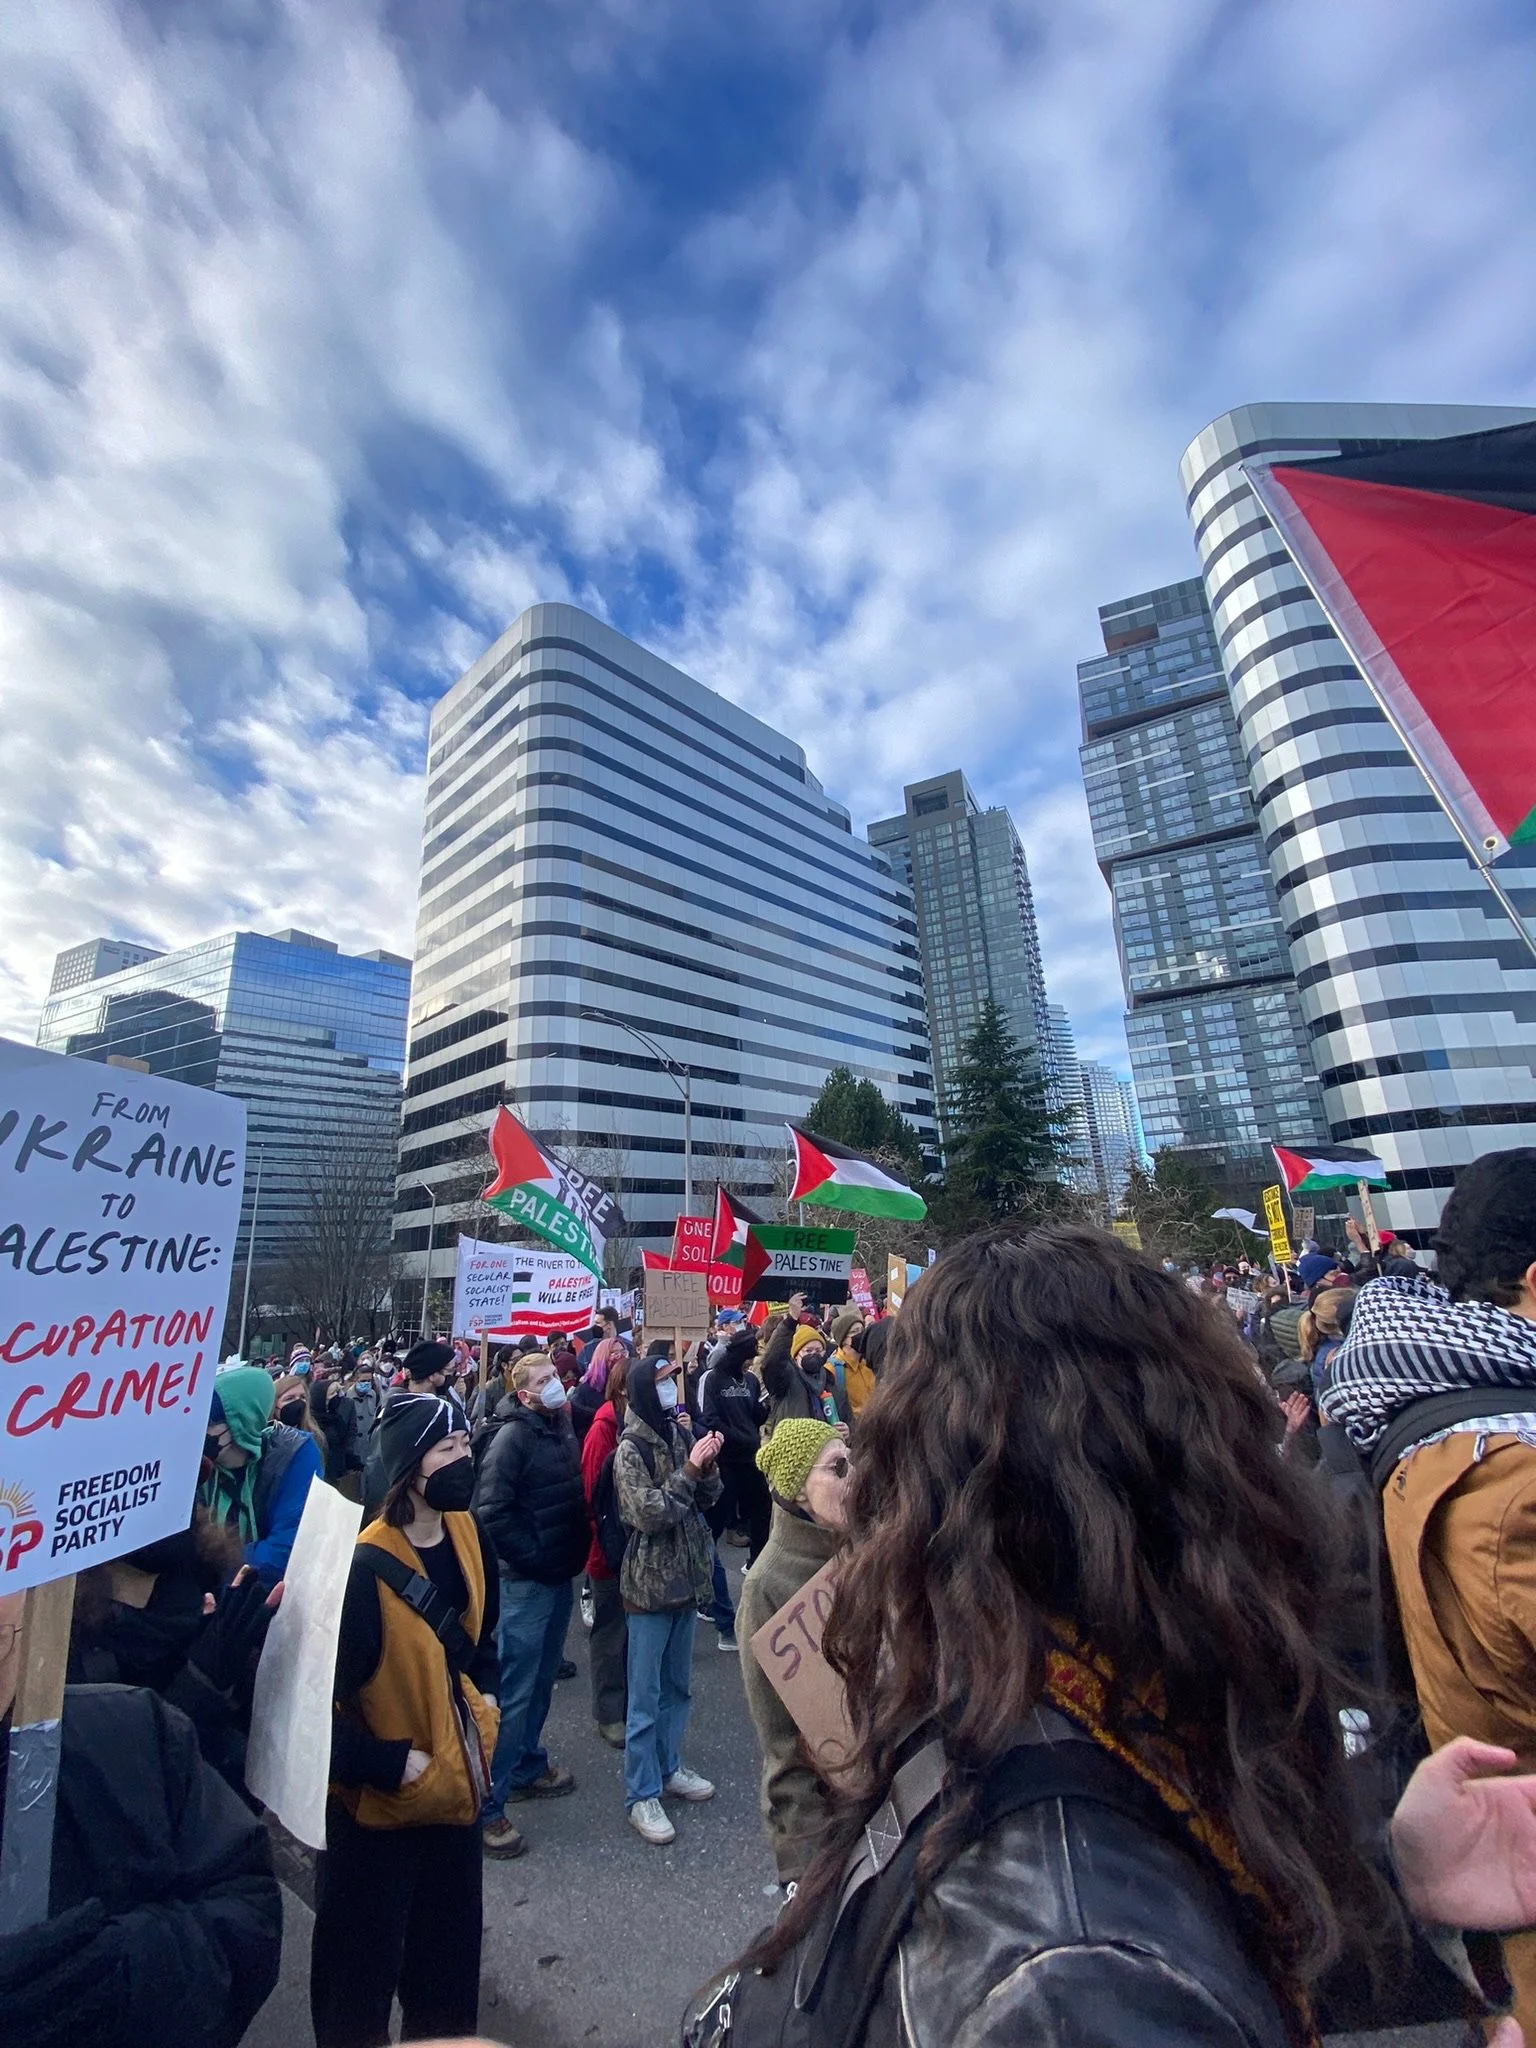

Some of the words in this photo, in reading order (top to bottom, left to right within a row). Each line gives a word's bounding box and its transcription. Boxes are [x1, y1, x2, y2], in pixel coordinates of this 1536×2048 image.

[91, 1092, 170, 1128] FROM
[101, 1193, 136, 1219] TO
[684, 1220, 712, 1238] ONE
[783, 1231, 830, 1251] FREE
[470, 1261, 488, 1270] FOR
[490, 1259, 507, 1269] ONE
[515, 1257, 534, 1266] THE
[537, 1259, 563, 1270] RIVER
[566, 1260, 575, 1268] TO
[775, 1253, 844, 1272] PALESTINE
[466, 1271, 511, 1282] SECULAR
[663, 1272, 700, 1293] FREE
[465, 1285, 510, 1295] SOCIALIST
[538, 1291, 562, 1304] WILL
[565, 1291, 577, 1302] BE
[469, 1294, 505, 1308] STATE!
[0, 1306, 214, 1363] CUPATION
[6, 1352, 203, 1438] CRIME!
[823, 1405, 832, 1416] G
[58, 1459, 161, 1506] FREEDOM
[54, 1482, 161, 1531] SOCIALIST
[51, 1515, 125, 1558] PARTY
